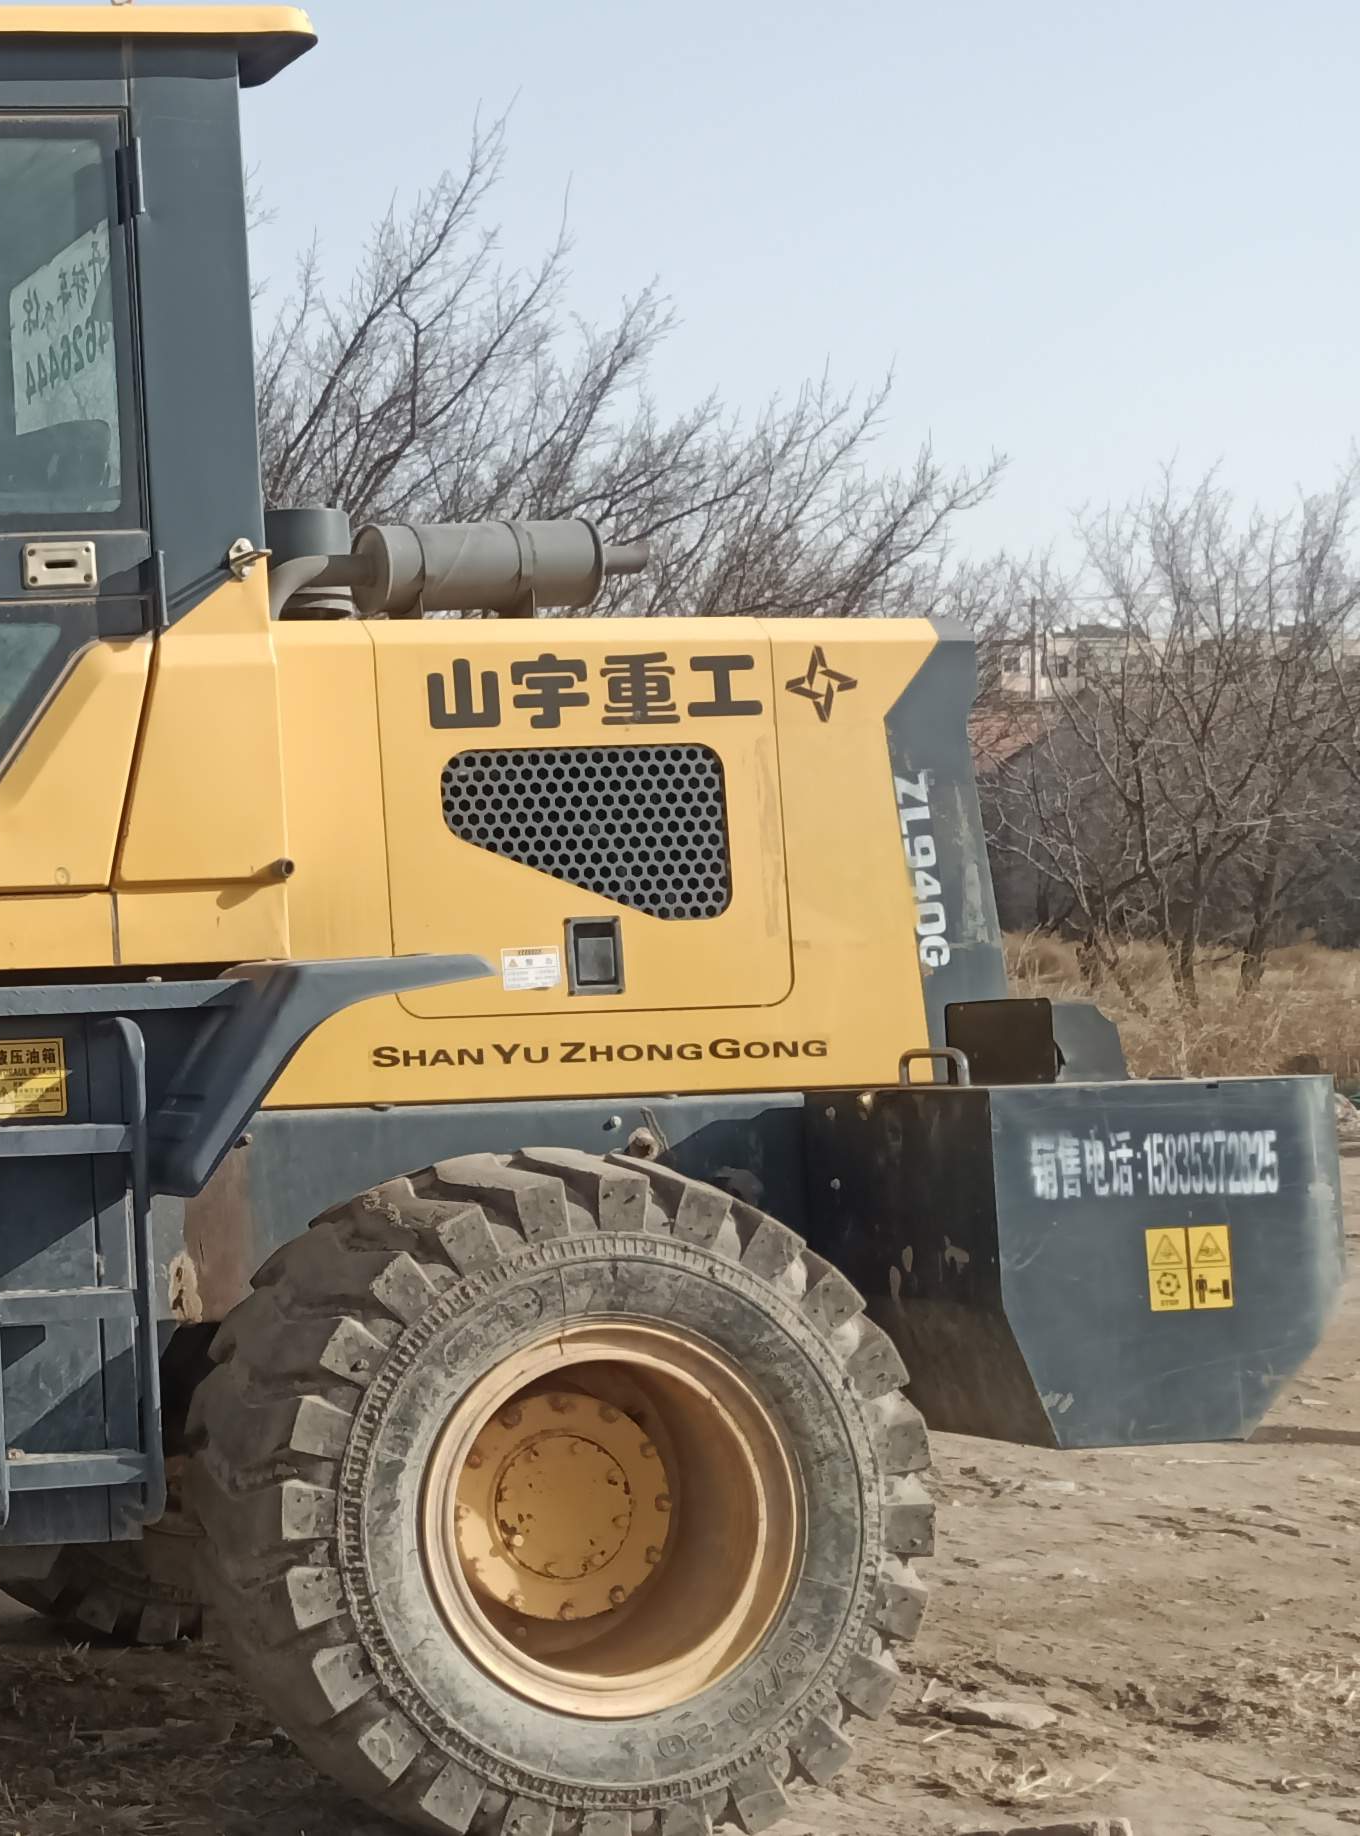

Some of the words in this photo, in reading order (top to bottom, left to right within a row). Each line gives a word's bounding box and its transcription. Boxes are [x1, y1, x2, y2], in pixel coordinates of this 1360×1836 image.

[426, 651, 763, 729] 山宇重工
[894, 768, 951, 968] ZL940G
[372, 1046, 484, 1068] SHAN
[492, 1043, 549, 1065] YU
